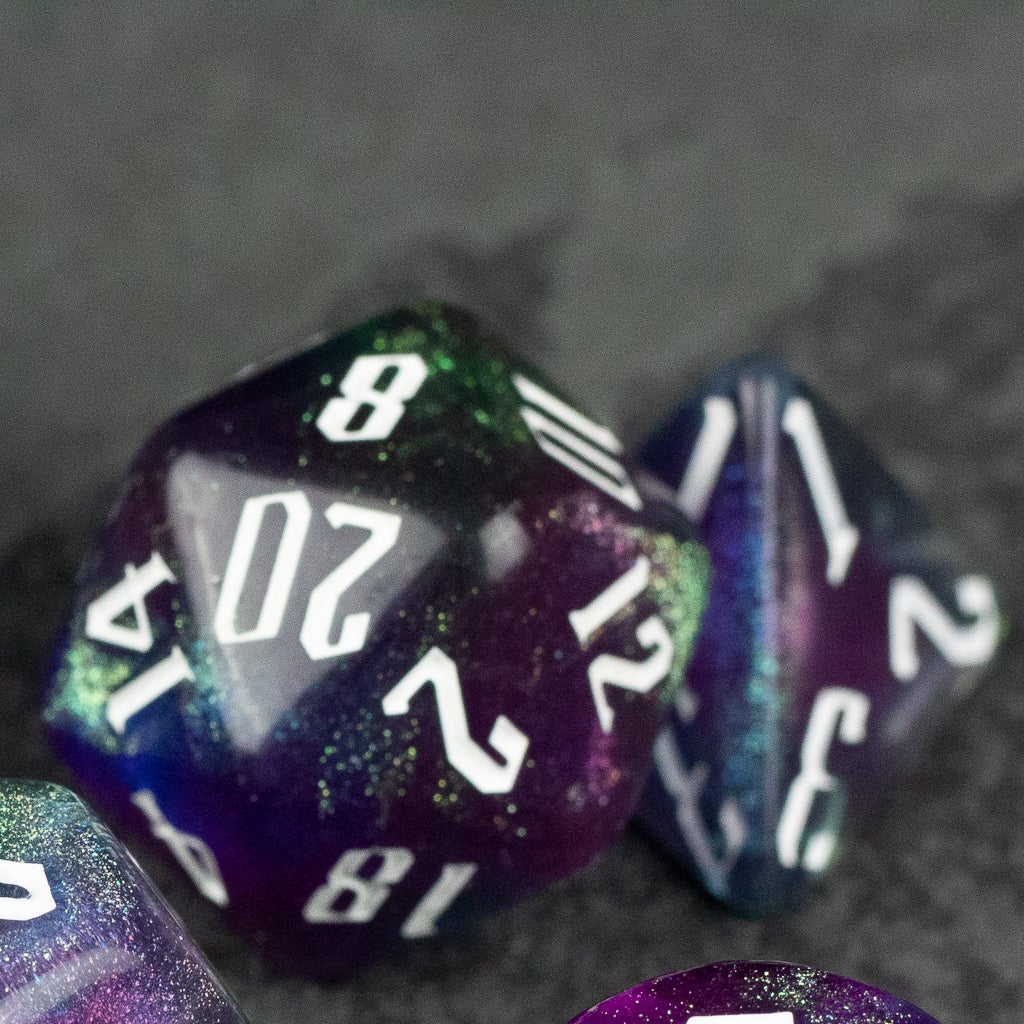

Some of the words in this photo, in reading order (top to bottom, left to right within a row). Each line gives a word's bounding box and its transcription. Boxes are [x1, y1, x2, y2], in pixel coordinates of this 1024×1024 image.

[316, 345, 430, 442] 8
[782, 397, 860, 586] 1
[84, 550, 198, 735] 14
[212, 489, 403, 661] 20
[567, 555, 676, 734] 12
[887, 573, 1002, 681] 2
[381, 645, 532, 796] 2
[302, 847, 479, 940] 18
